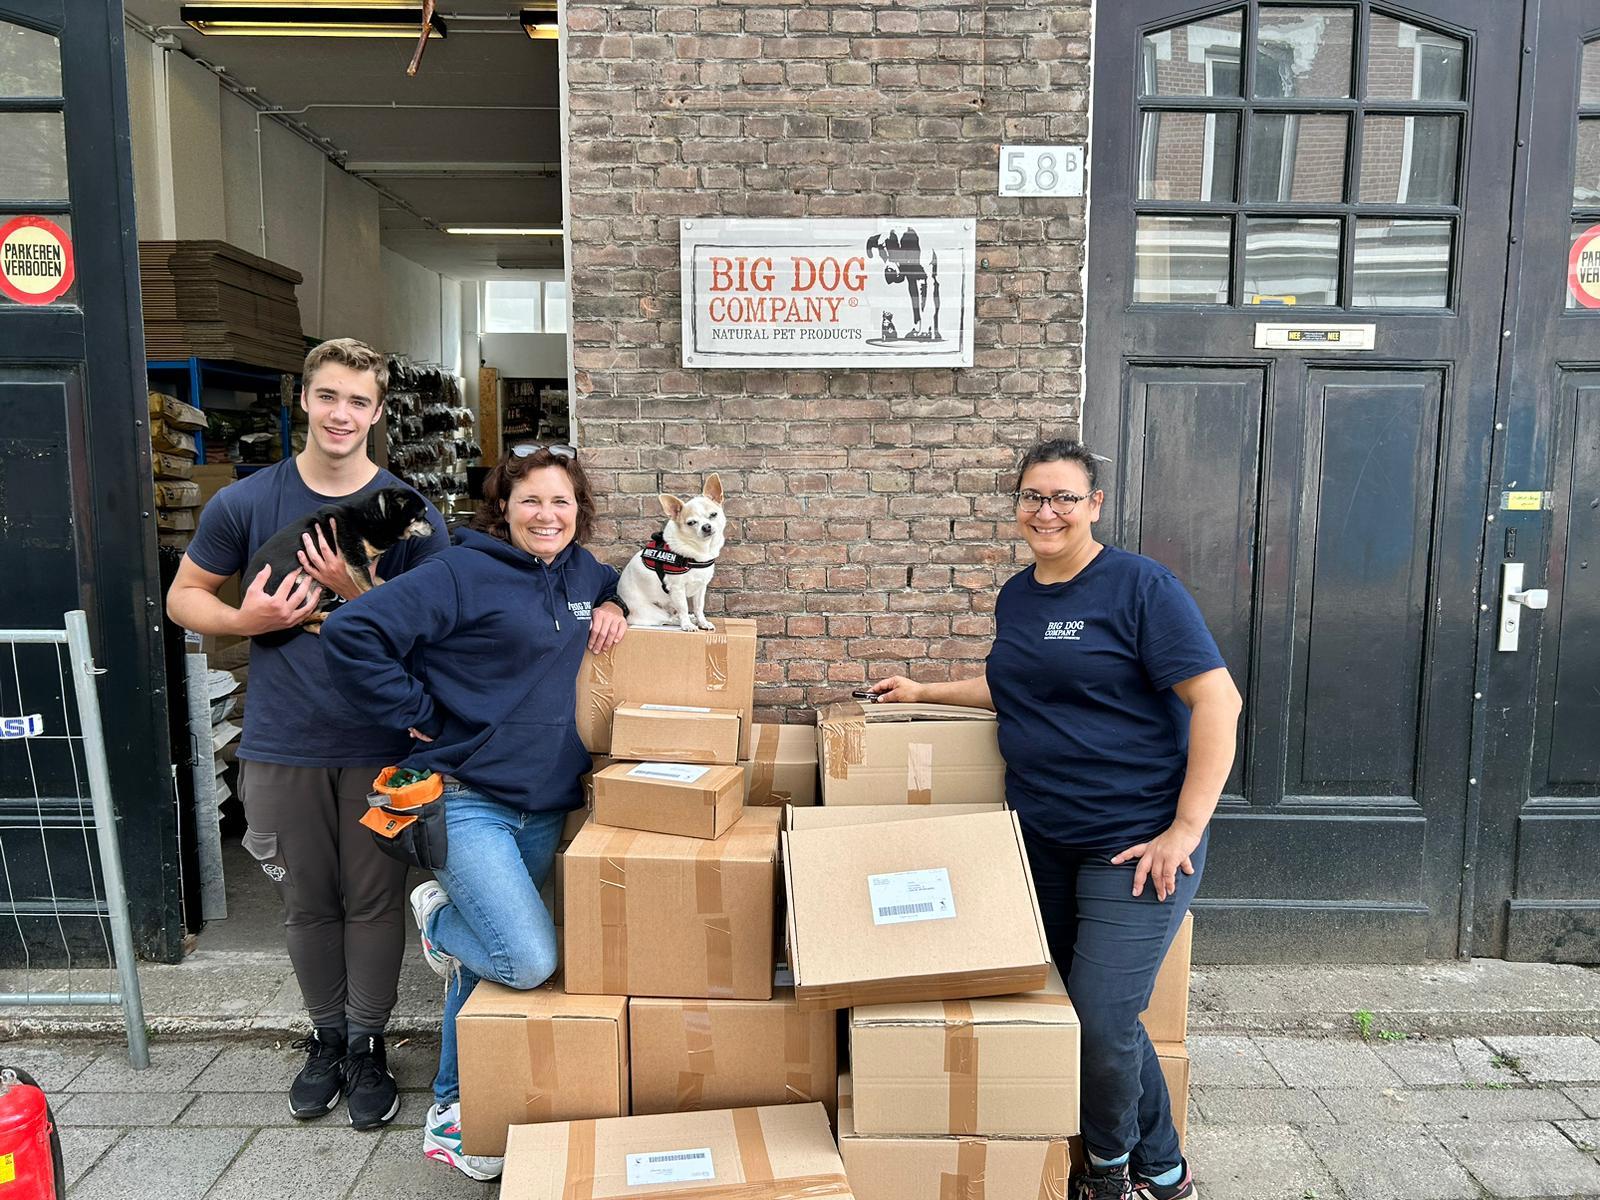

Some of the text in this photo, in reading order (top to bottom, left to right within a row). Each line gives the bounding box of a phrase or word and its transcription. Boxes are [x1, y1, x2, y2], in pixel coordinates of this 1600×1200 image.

[4, 243, 60, 260] PARKEREN
[4, 260, 62, 276] VERBODEN
[709, 256, 868, 292] BIG DOG
[712, 328, 862, 340] NATURAL PET PRODUCTS
[1047, 620, 1084, 631] BIG DOG
